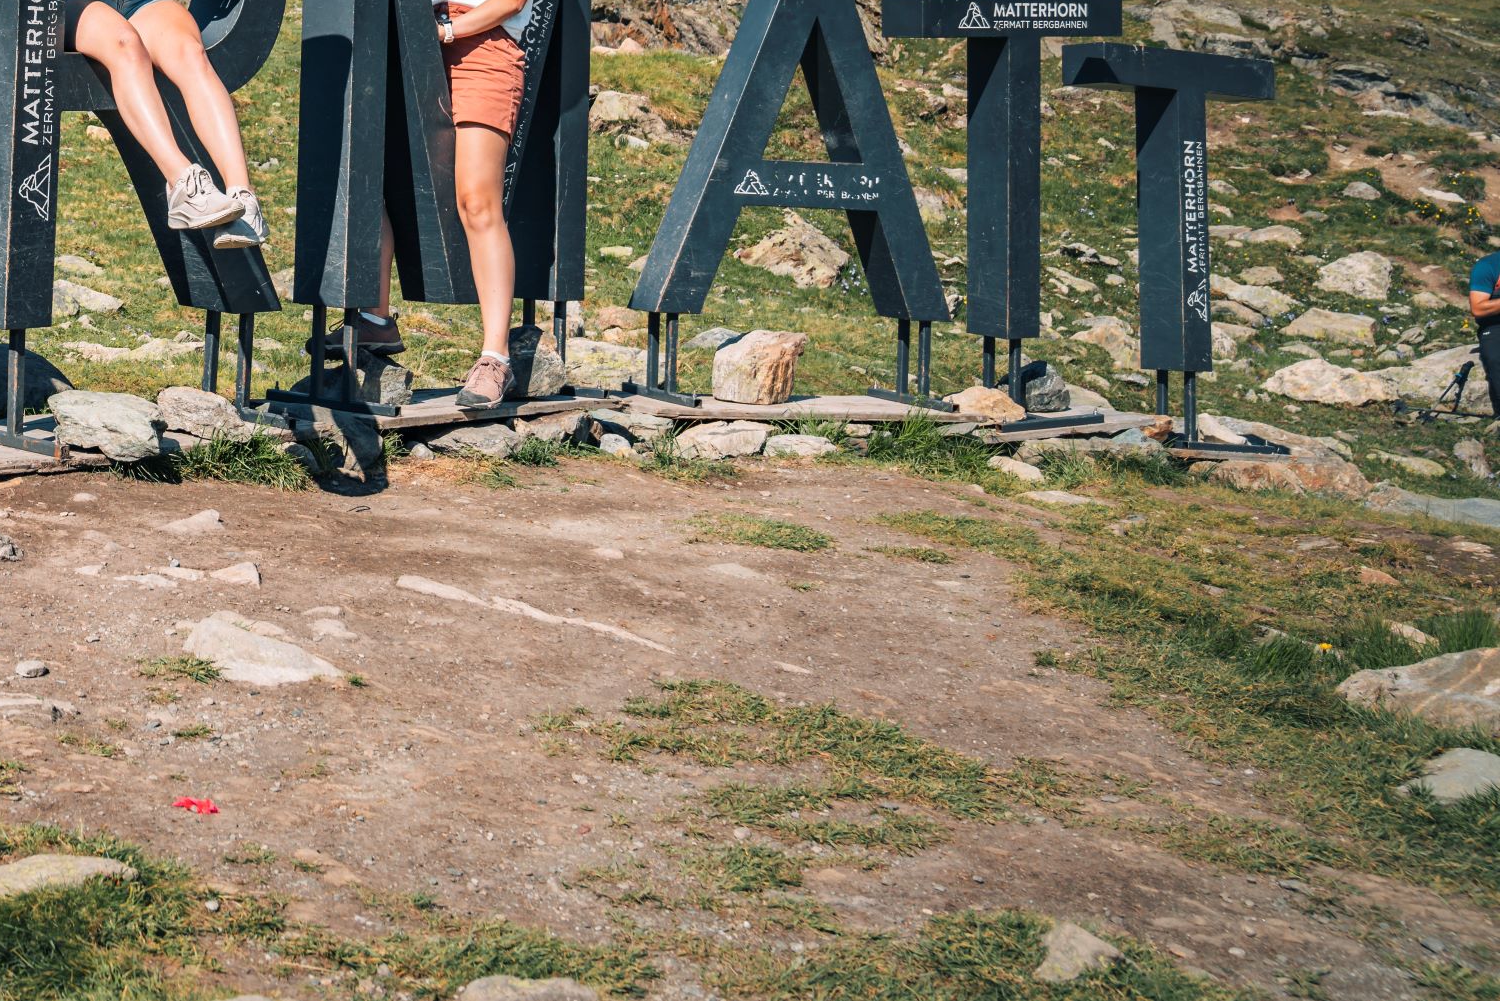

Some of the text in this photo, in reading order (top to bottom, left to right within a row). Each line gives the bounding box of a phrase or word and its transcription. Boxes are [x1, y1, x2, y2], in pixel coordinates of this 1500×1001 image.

[993, 2, 1088, 17] MATTERHORN
[993, 20, 1088, 30] ZERMATT BERGBAHNEN
[42, 67, 55, 146] ZERMATT
[1183, 140, 1197, 273] MATTERHORN
[1196, 141, 1204, 219] BERGBAHNEN
